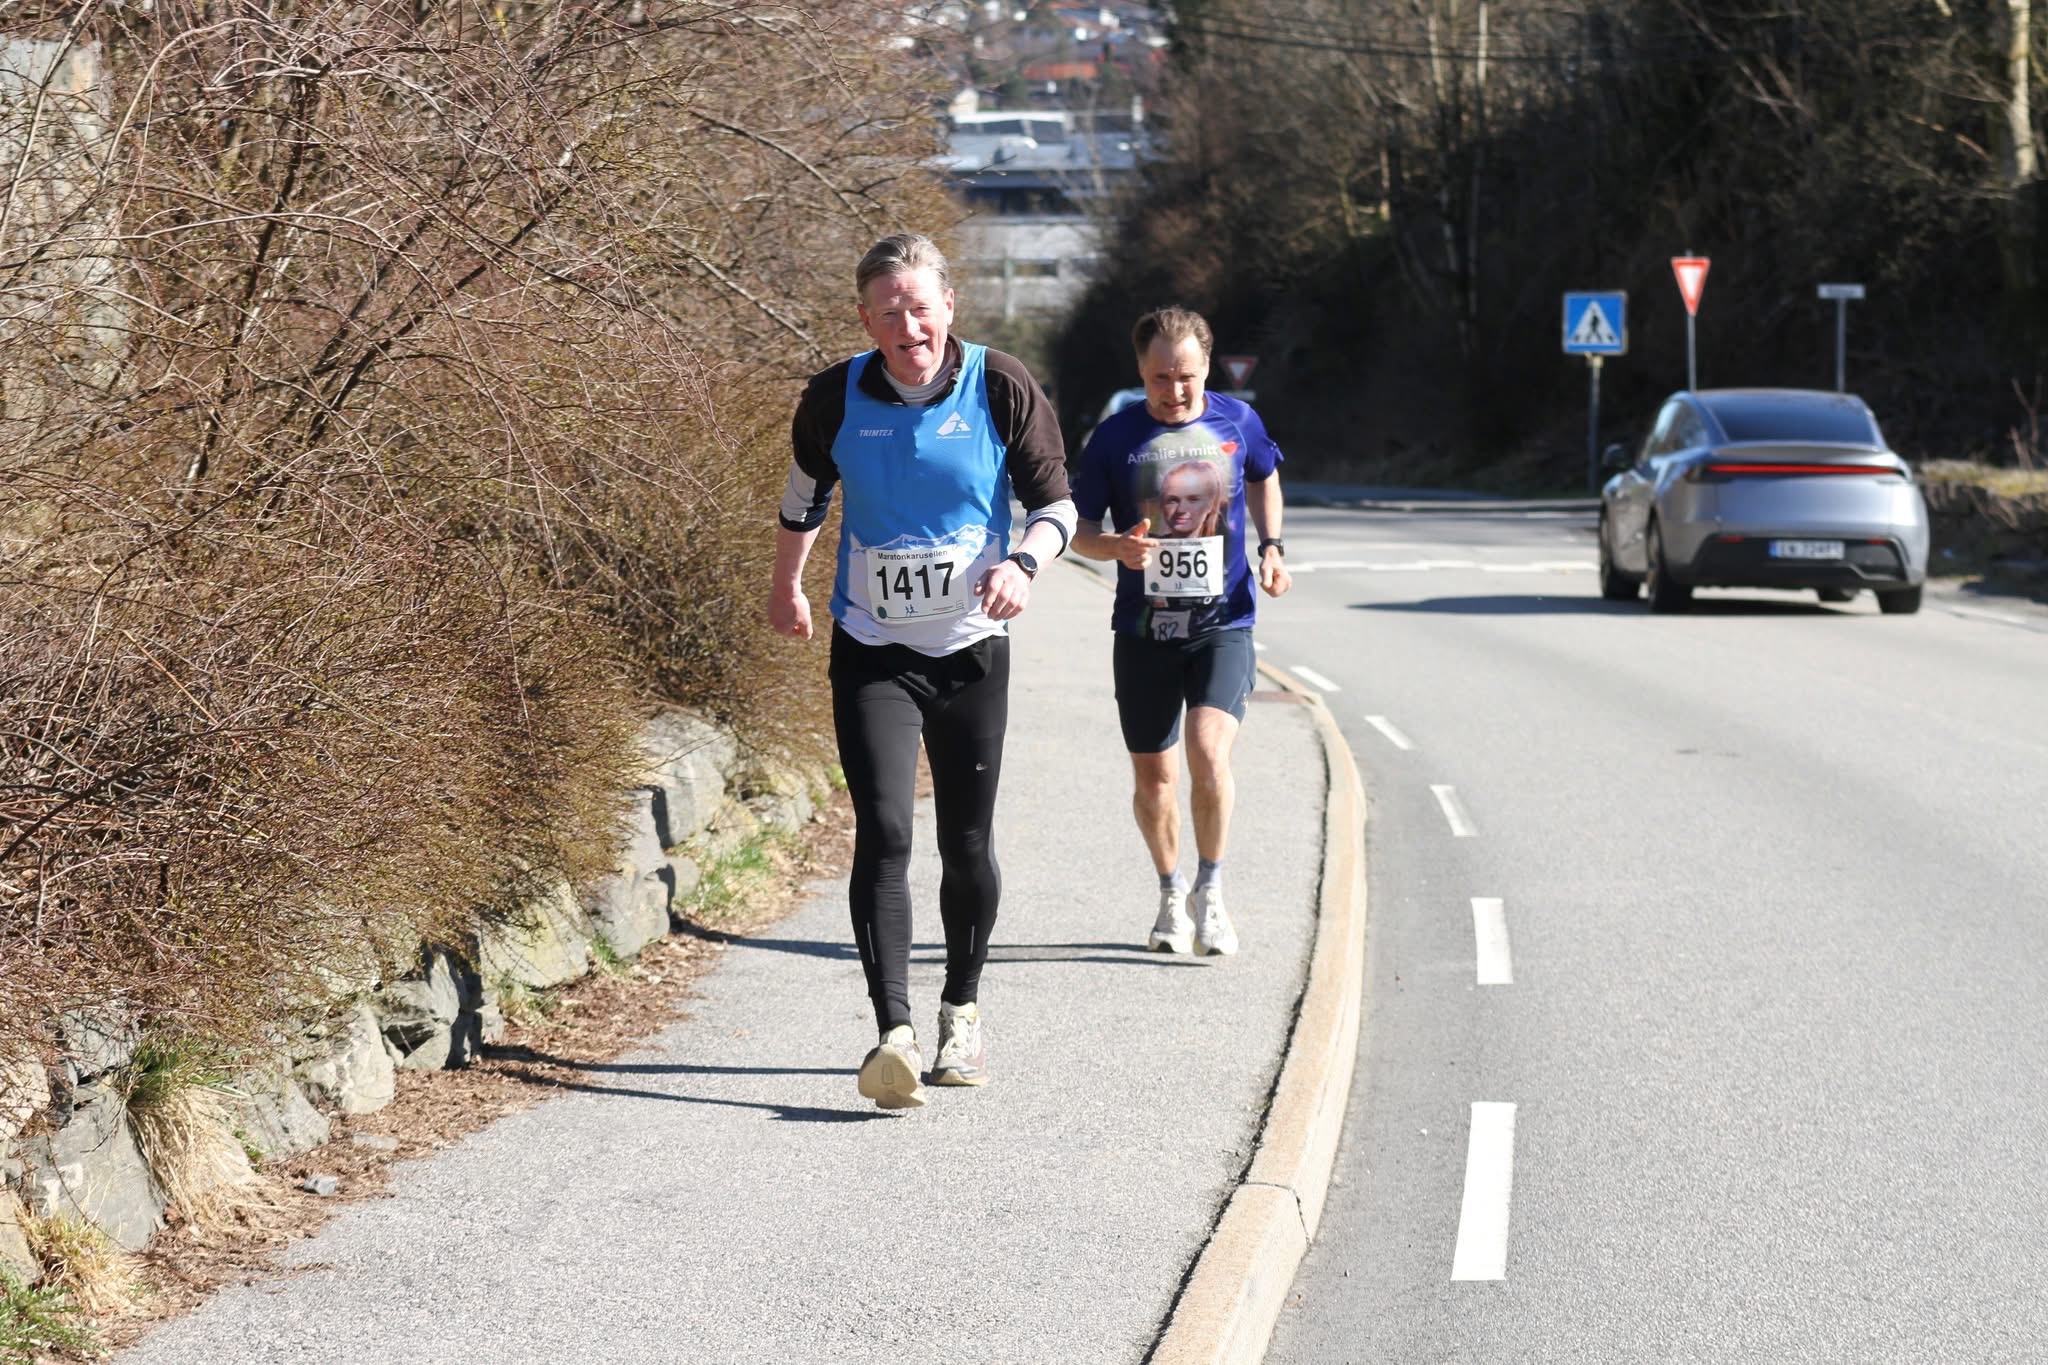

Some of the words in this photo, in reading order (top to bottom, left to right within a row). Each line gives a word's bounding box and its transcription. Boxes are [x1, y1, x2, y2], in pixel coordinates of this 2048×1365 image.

[859, 429, 895, 438] TRIMTEX
[1127, 448, 1177, 464] Amalie
[1188, 443, 1219, 457] mitt
[877, 550, 948, 561] Maratonkarusellen
[1159, 549, 1209, 579] 956
[876, 561, 954, 601] 1417
